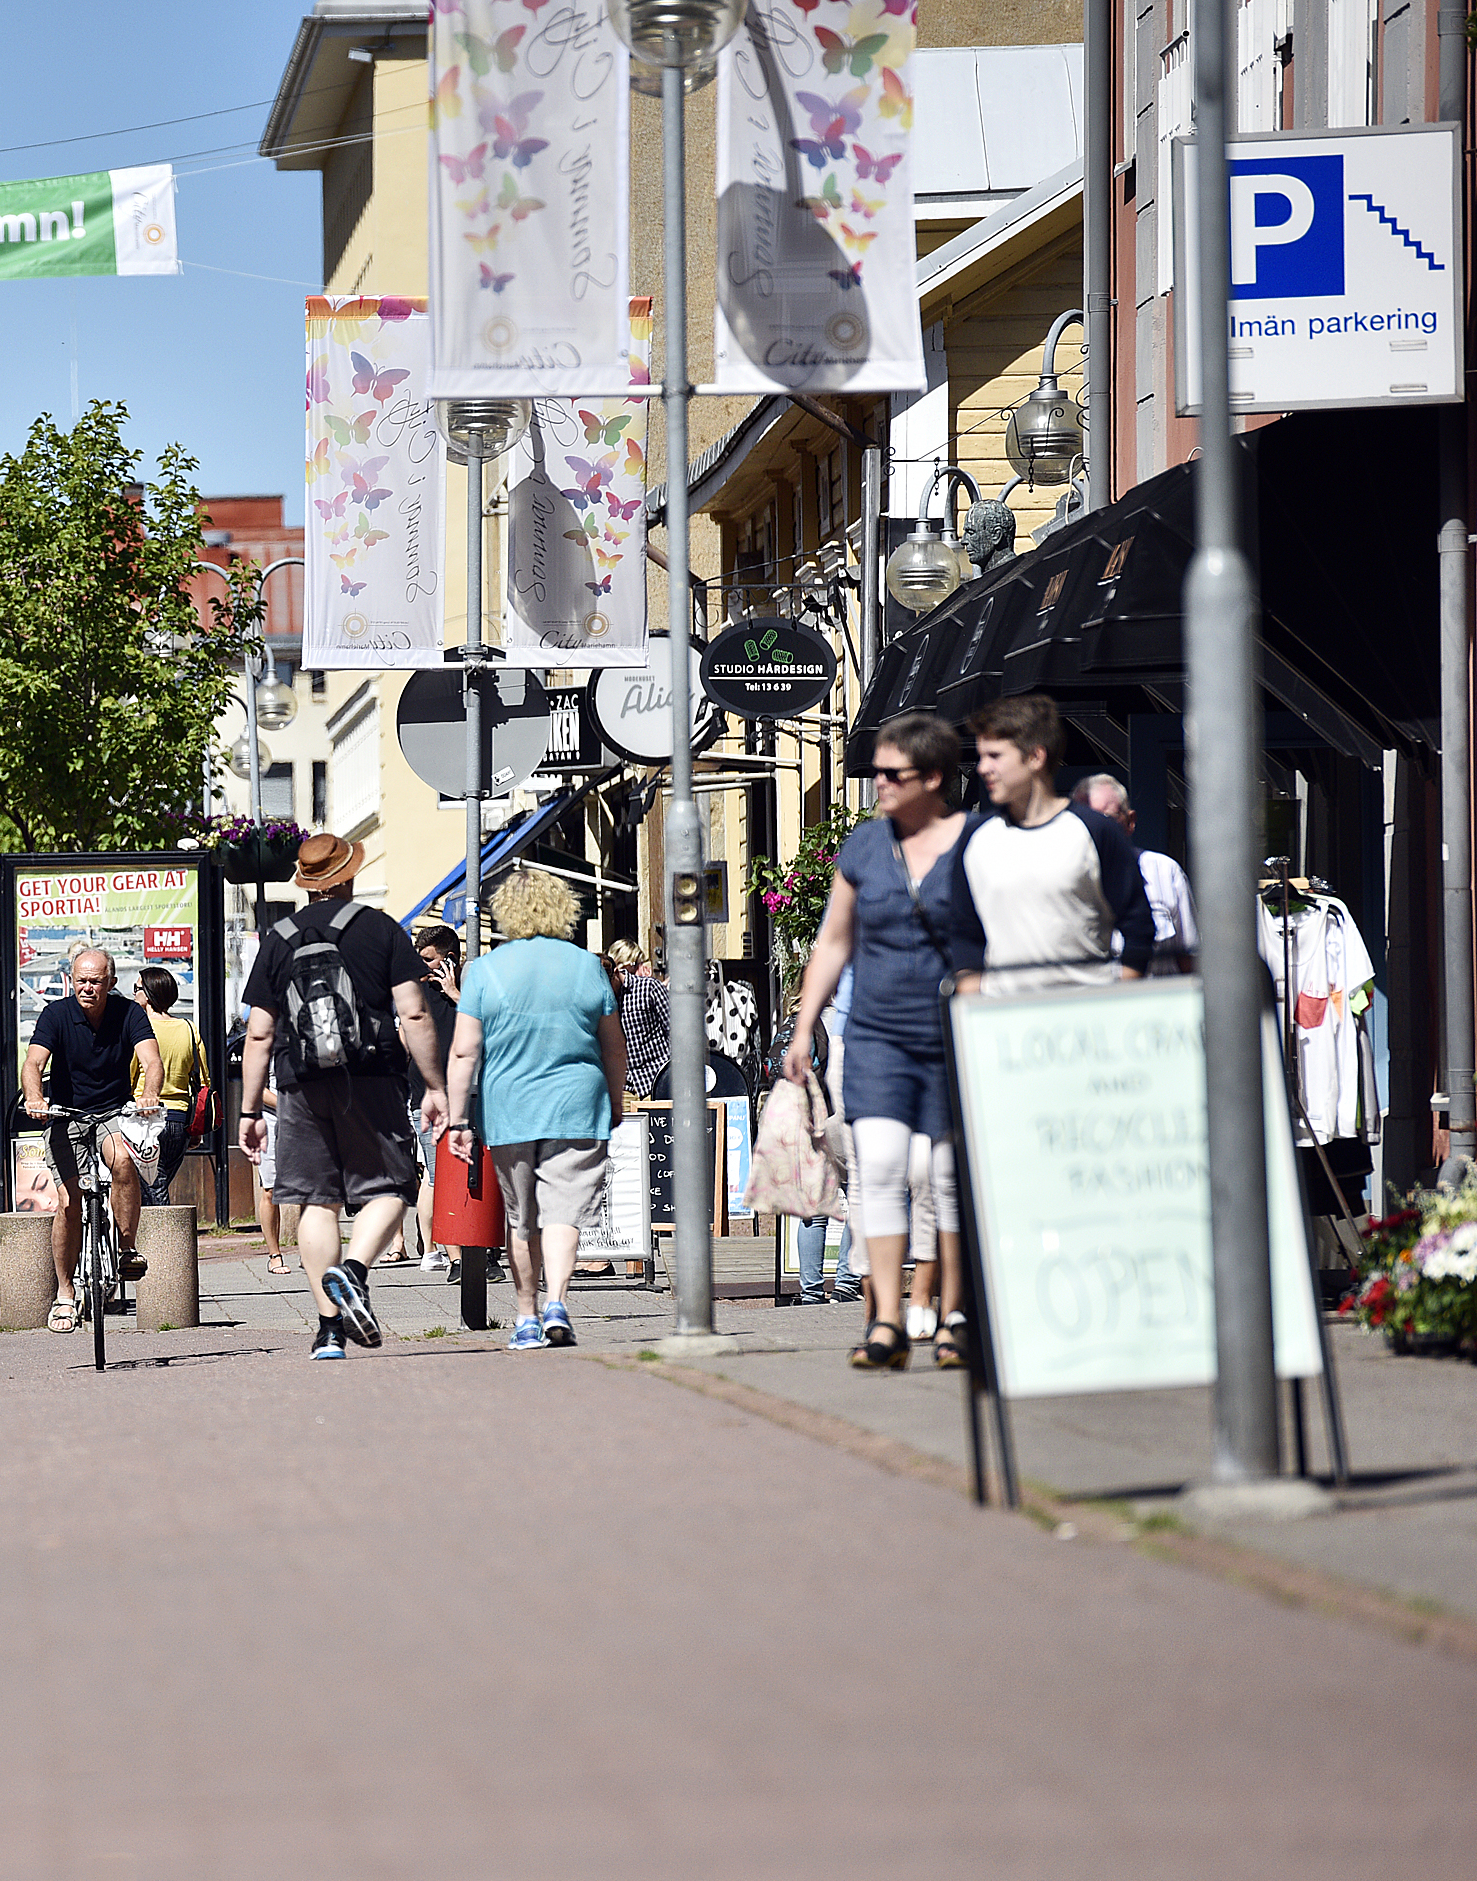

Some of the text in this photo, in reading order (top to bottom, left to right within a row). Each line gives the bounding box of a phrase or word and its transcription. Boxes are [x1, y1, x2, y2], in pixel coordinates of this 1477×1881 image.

[1230, 174, 1315, 285] P
[1230, 308, 1437, 340] lmän parkering
[515, 494, 556, 602] Sommar
[539, 630, 583, 665] City
[714, 662, 824, 675] STUDIO HÅRDESIGN
[744, 682, 792, 691] Tel: 13 6 39
[556, 693, 579, 710] ZAC
[548, 711, 580, 751] IKEN
[19, 869, 188, 897] GET YOUR GEAR AT
[20, 897, 101, 918] SPORTIA!
[153, 930, 181, 947] HH
[164, 945, 189, 953] HANSEN
[650, 1116, 668, 1128] IVE
[19, 1144, 45, 1159] Som
